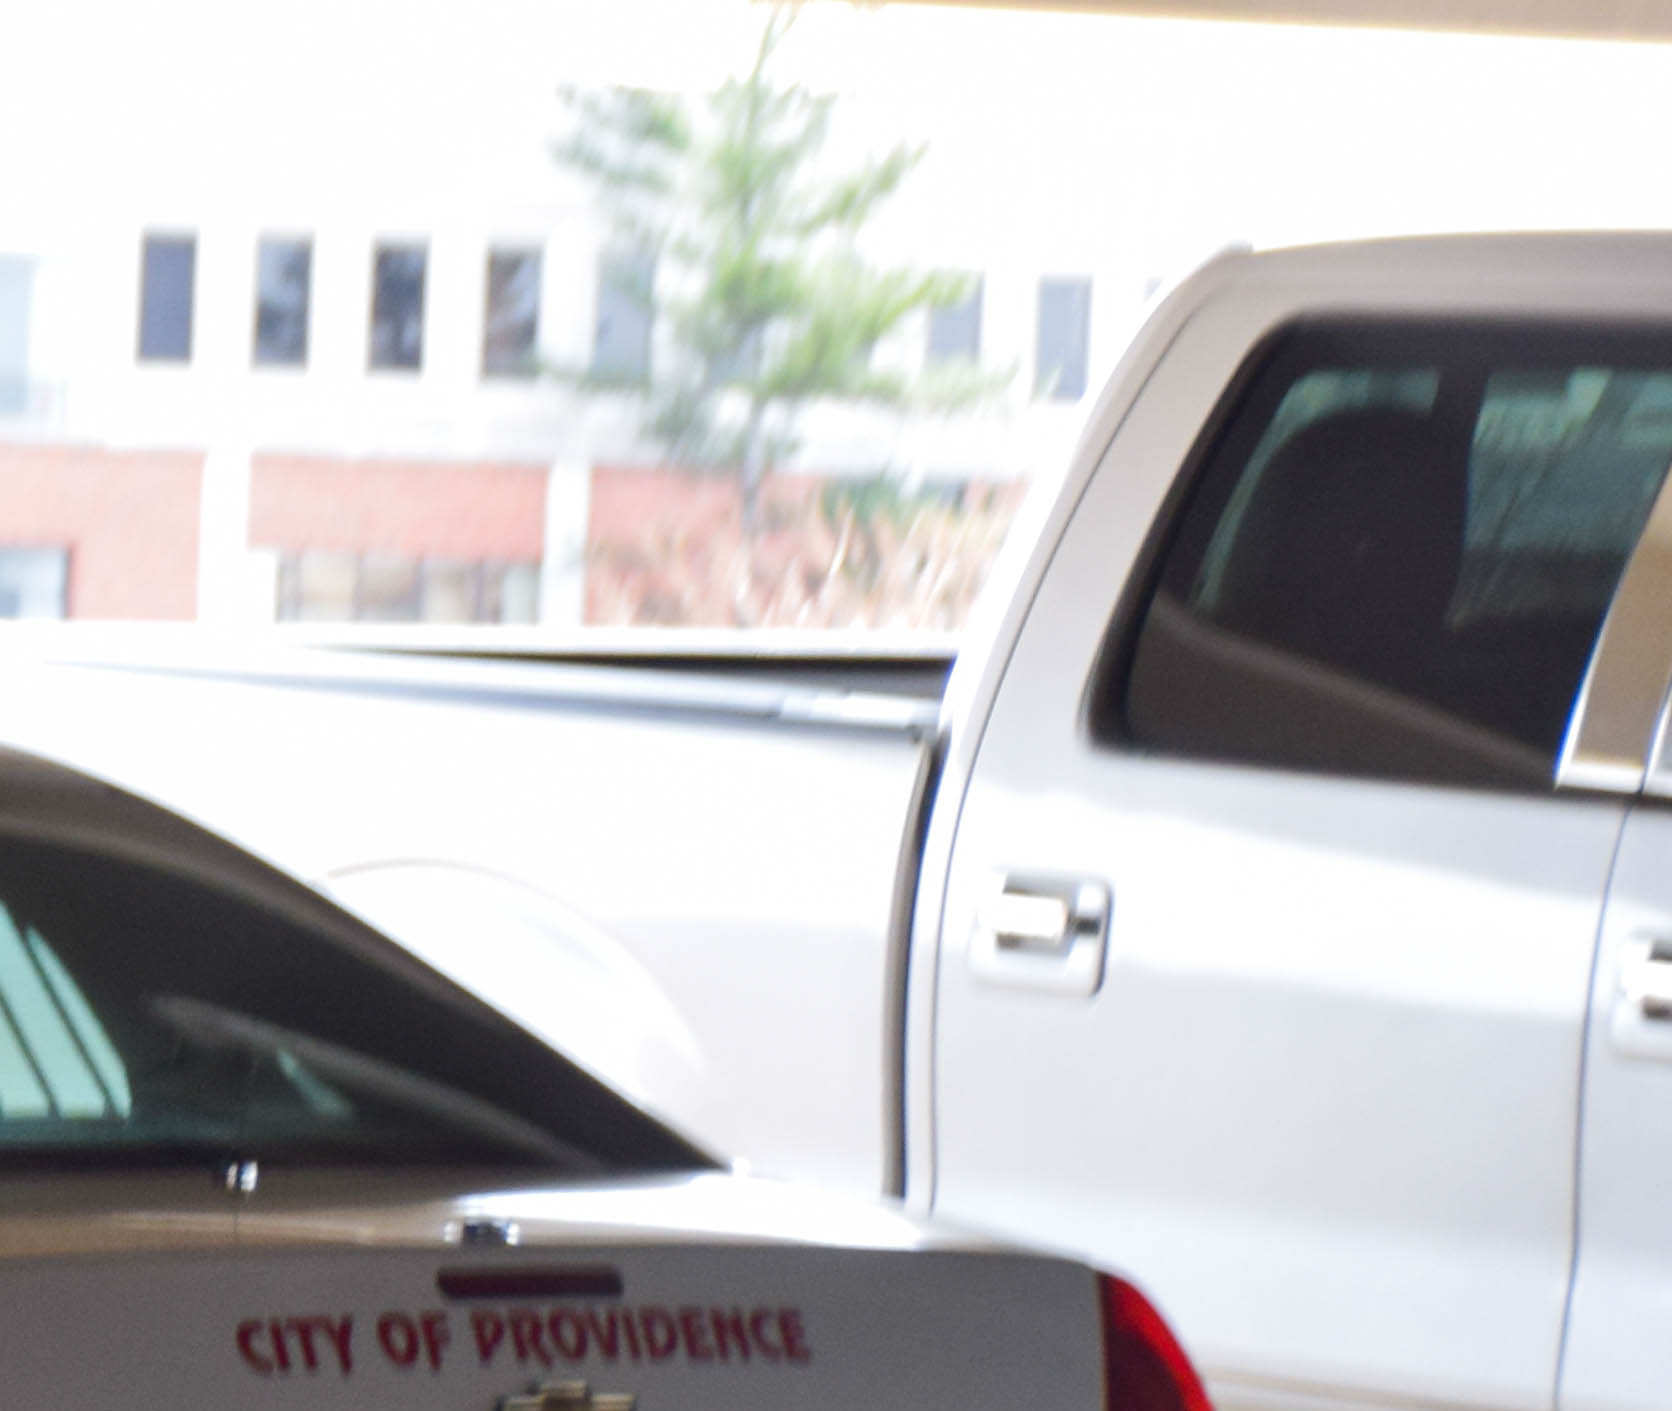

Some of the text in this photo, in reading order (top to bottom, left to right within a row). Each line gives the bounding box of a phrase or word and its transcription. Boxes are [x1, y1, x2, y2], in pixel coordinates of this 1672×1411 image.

[236, 1306, 811, 1376] CITY OF PROVIDENCE
